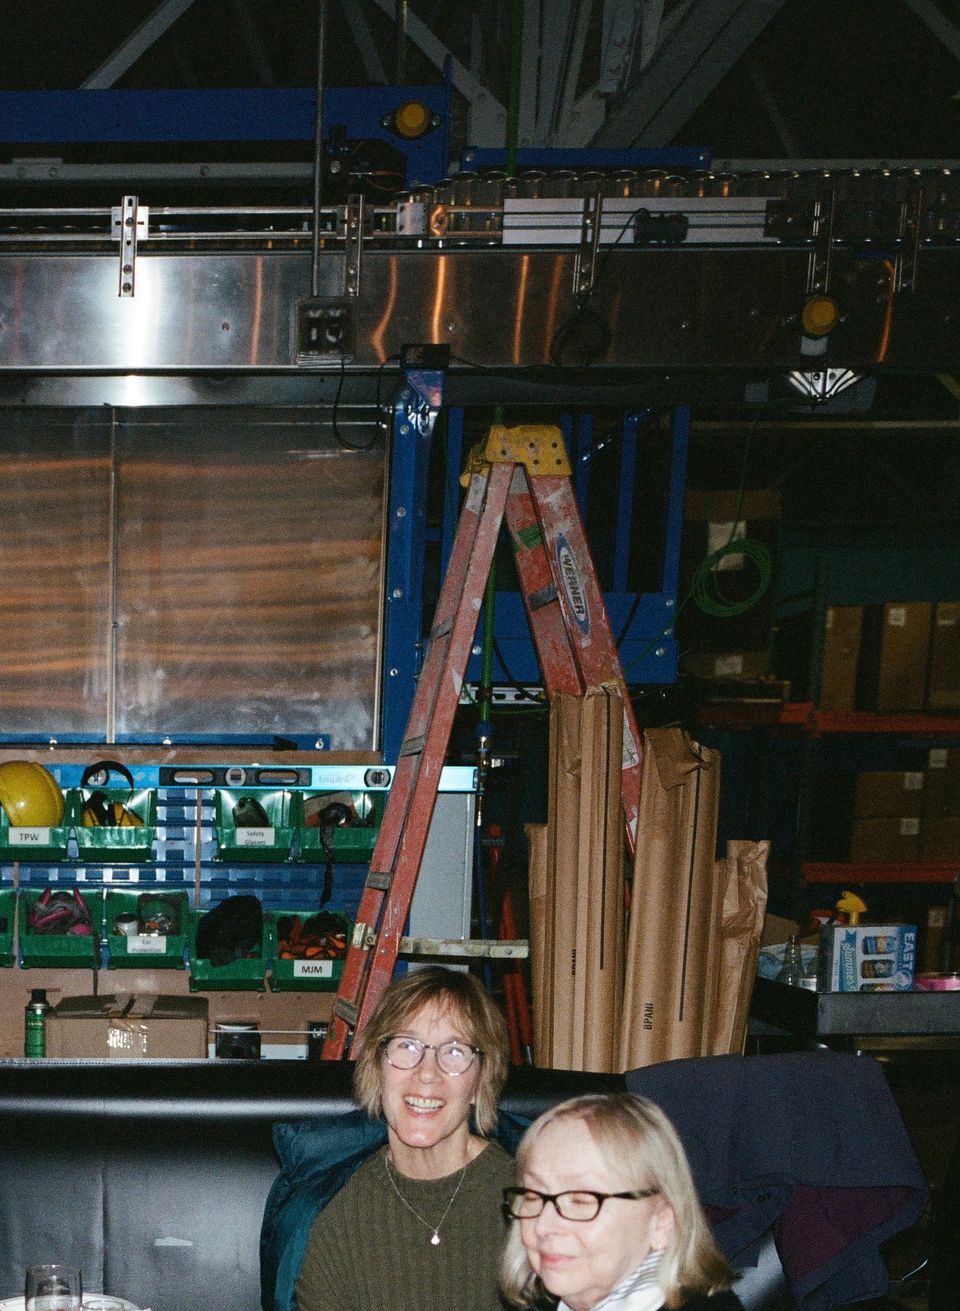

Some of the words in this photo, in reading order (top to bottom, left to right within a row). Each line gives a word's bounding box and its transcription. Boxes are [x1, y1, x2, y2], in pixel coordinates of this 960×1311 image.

[561, 554, 585, 615] WERNER
[19, 833, 39, 841] TPW
[903, 932, 915, 971] EAST
[301, 965, 323, 973] MJM
[643, 1003, 654, 1030] BPANI
